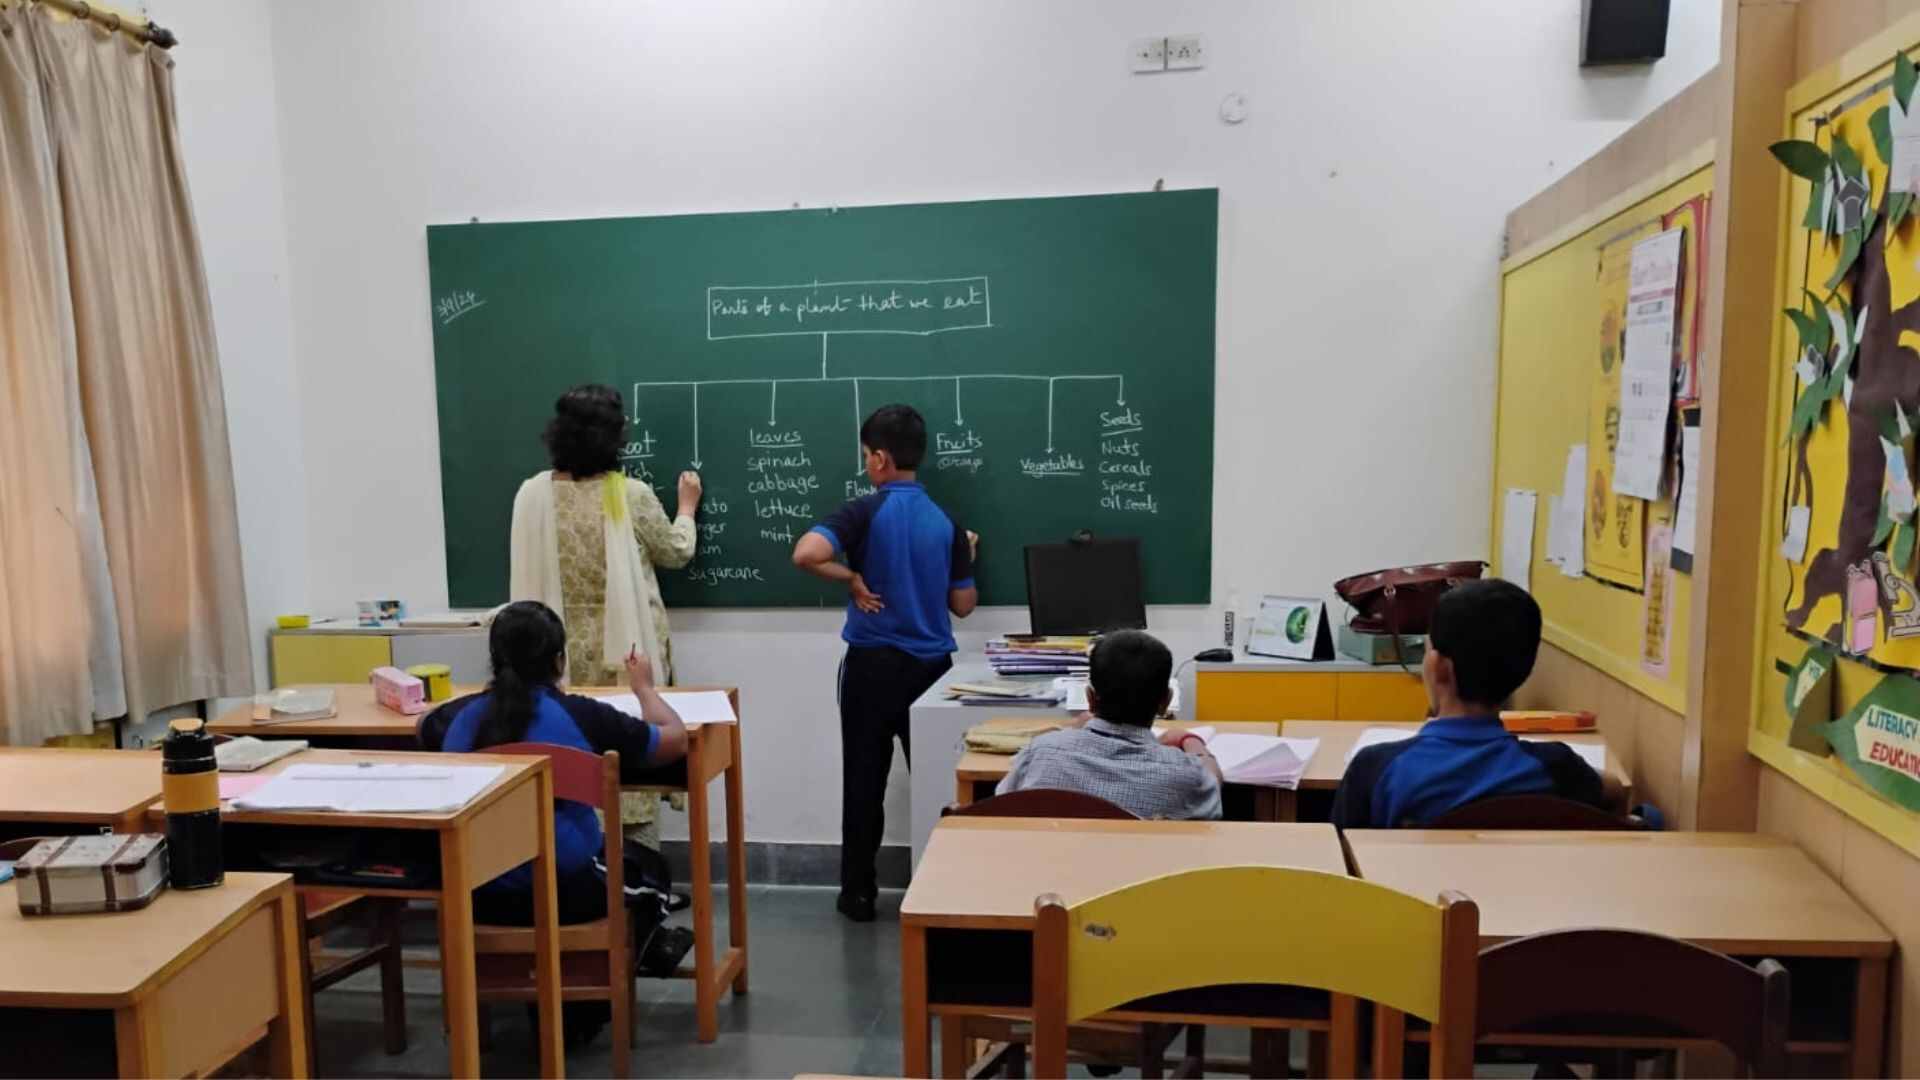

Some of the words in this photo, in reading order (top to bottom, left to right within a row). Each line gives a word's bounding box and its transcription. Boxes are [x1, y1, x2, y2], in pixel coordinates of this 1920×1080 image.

[756, 296, 773, 316] of
[779, 302, 793, 313] a
[797, 295, 852, 323] plant
[857, 289, 904, 311] that
[909, 298, 935, 309] we
[943, 286, 983, 310] eat
[1099, 408, 1142, 427] Seeds
[617, 430, 657, 455] oot
[749, 428, 802, 445] leaves
[936, 430, 983, 450] Fruits
[1102, 438, 1139, 456] Nuts
[1099, 460, 1152, 476] Cereals
[747, 473, 820, 495] cabbage
[703, 497, 728, 515] ato
[754, 497, 813, 518] lettuce
[1100, 495, 1122, 509] Oil
[760, 523, 793, 543] mint
[1866, 708, 1919, 740] LITERACY
